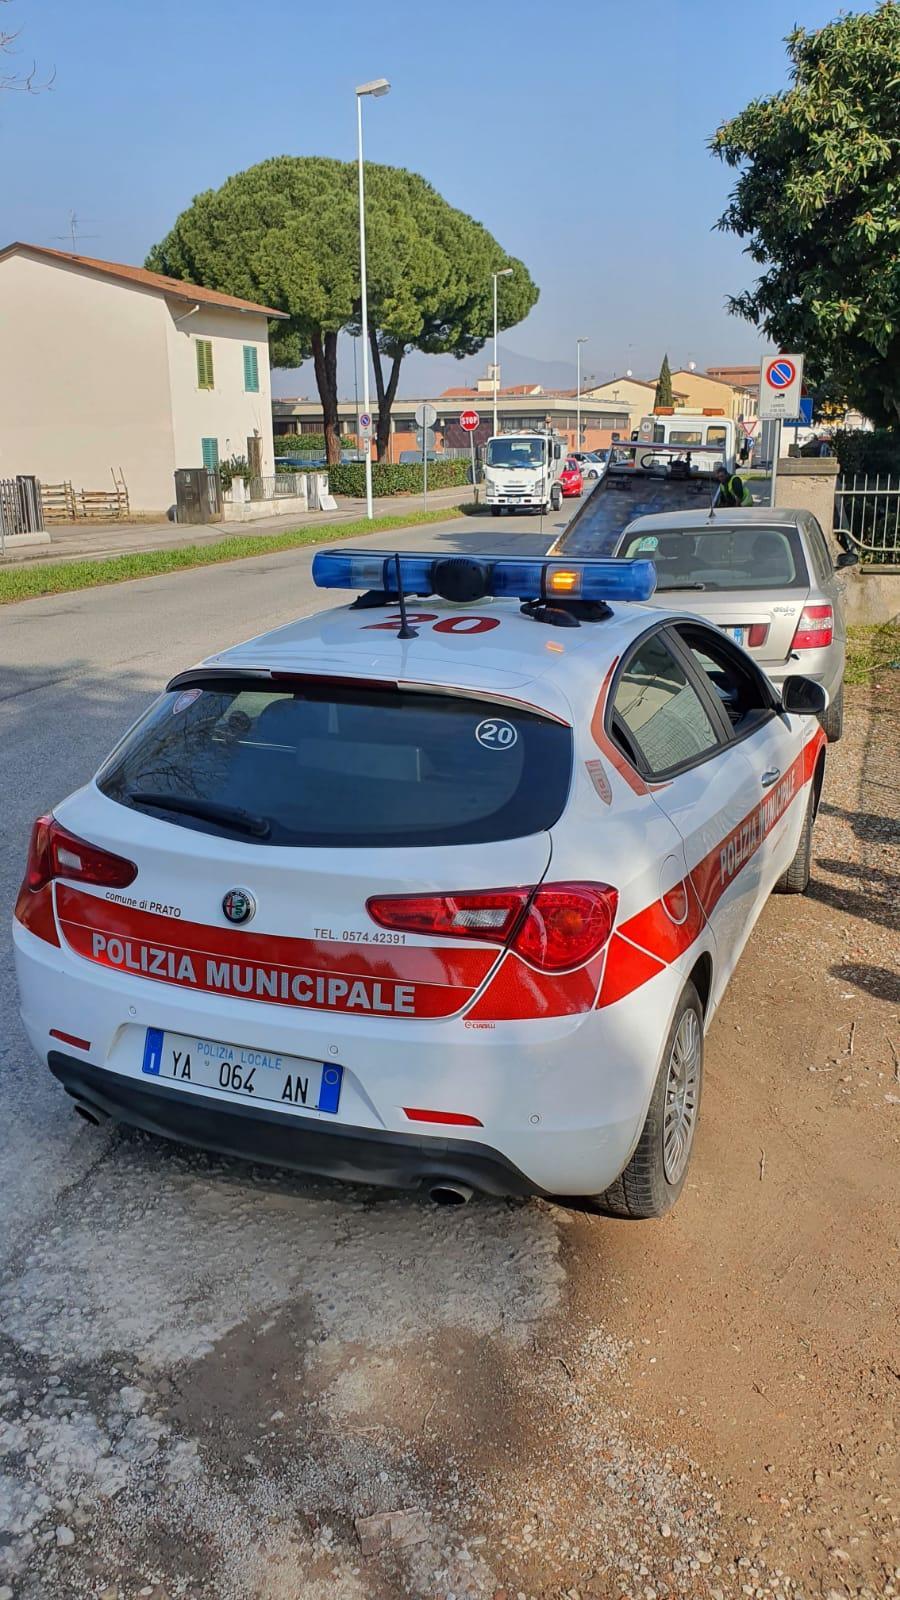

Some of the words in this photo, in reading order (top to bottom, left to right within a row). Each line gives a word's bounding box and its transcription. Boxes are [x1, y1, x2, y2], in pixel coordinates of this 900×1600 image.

[462, 416, 478, 424] STOP
[359, 613, 501, 634] 20
[480, 723, 513, 744] 20
[720, 815, 757, 885] POLIZIA
[105, 891, 137, 908] comune
[139, 899, 148, 910] di
[149, 902, 182, 918] PRATO
[313, 927, 339, 941] TEL.
[342, 930, 407, 945] 0574.42391
[92, 932, 198, 983] POLIZIA
[206, 959, 416, 1014] MUNICIPALE
[197, 1042, 234, 1061] POLIZIA
[240, 1053, 282, 1071] LOCALE
[172, 1050, 192, 1081] YA
[218, 1062, 256, 1093] 064
[281, 1074, 309, 1105] AN
